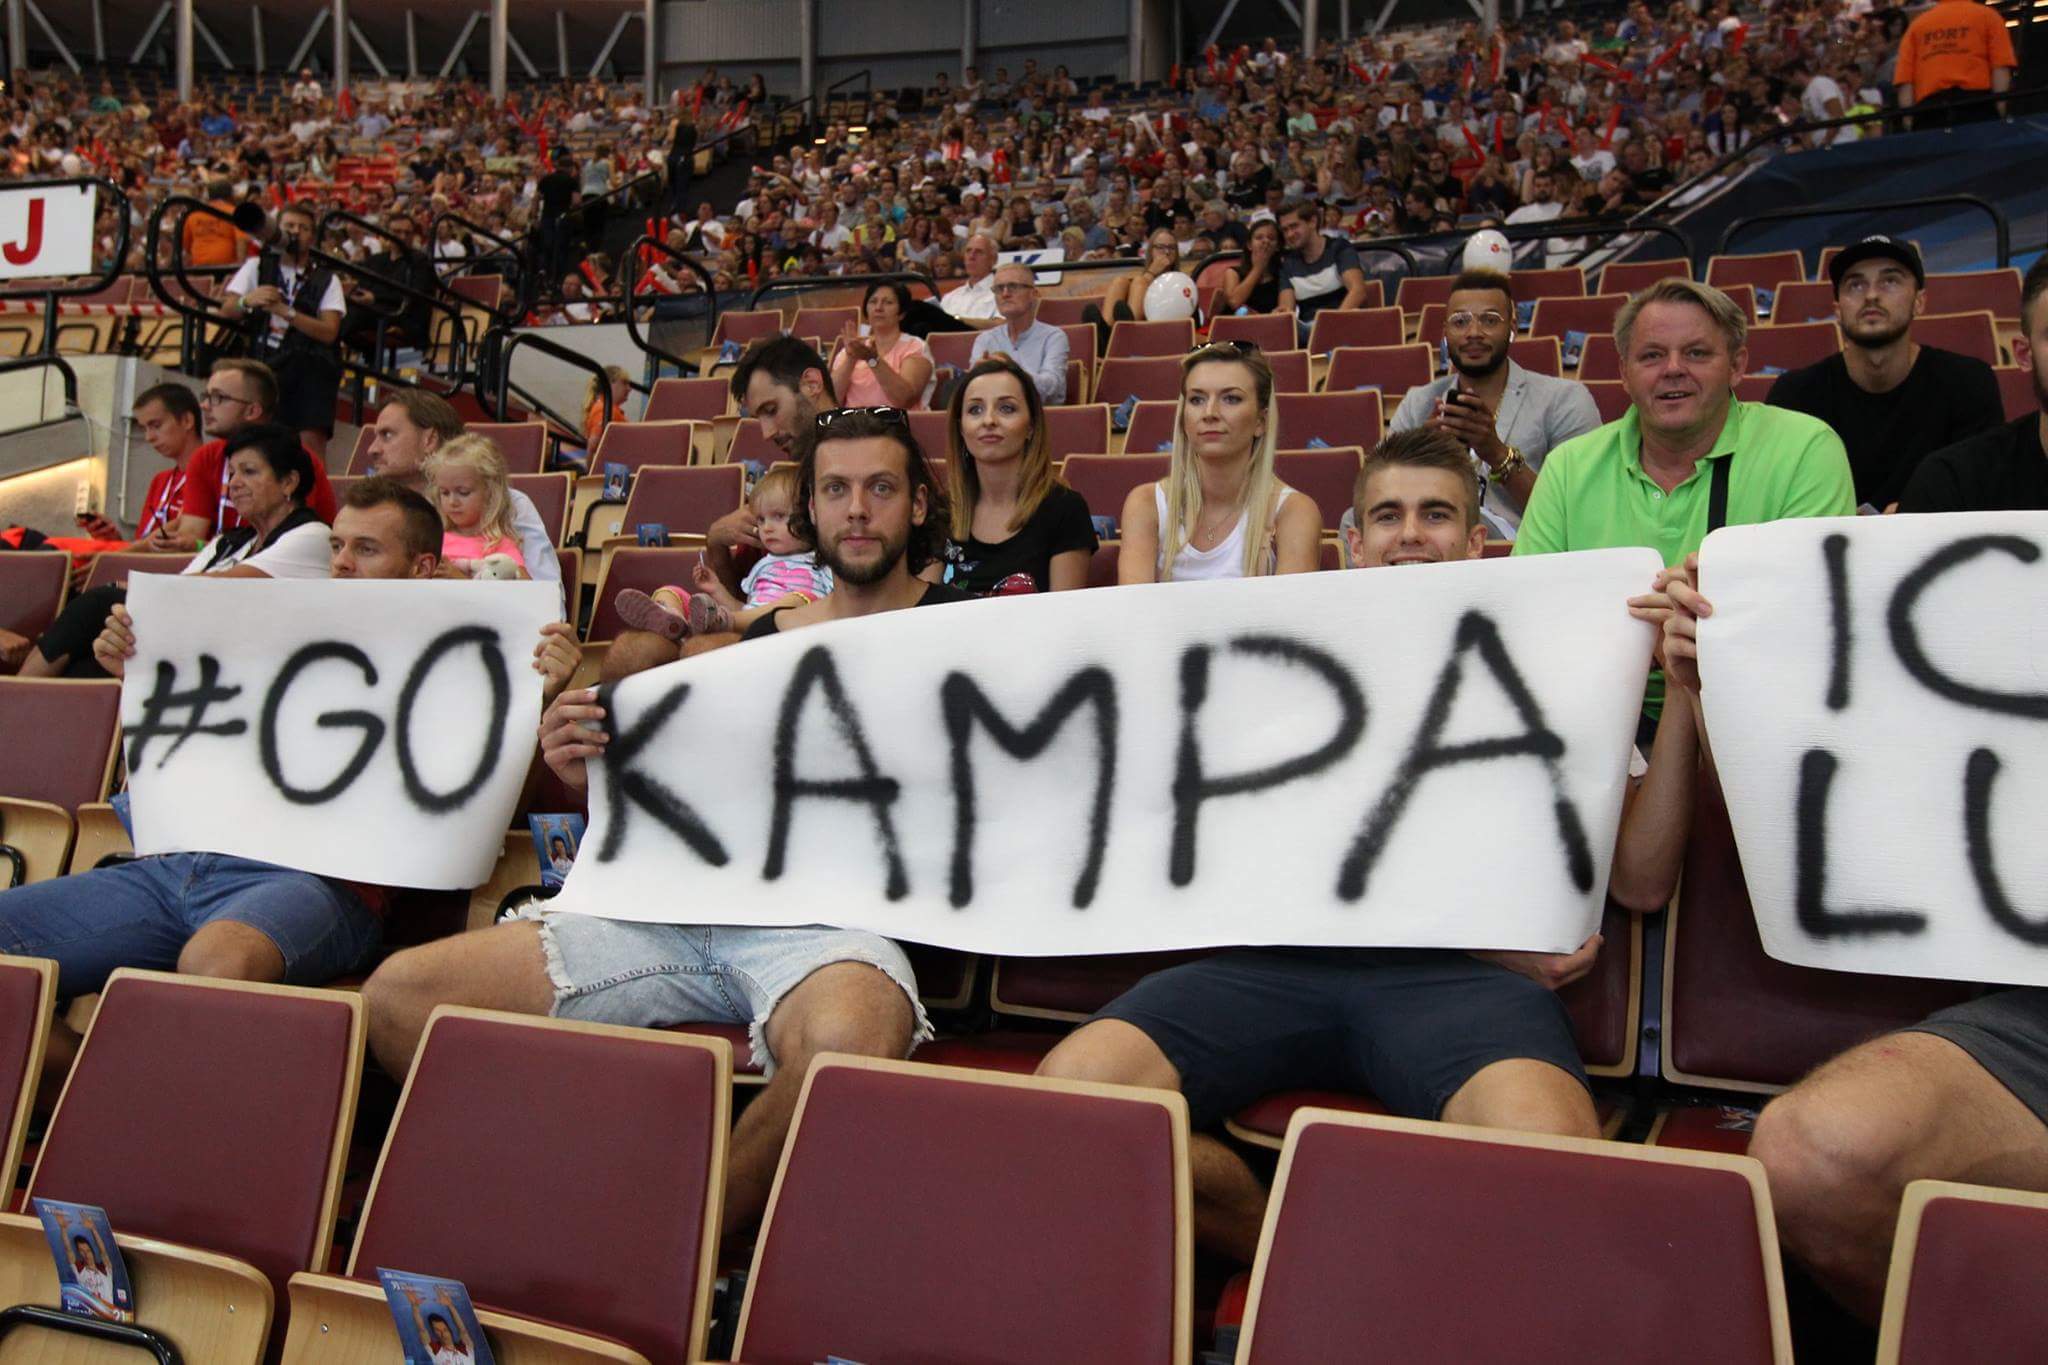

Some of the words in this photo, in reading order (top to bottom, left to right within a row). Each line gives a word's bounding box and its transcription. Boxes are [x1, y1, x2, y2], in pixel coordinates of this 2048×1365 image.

[3, 198, 45, 266] J
[123, 624, 511, 816] #GO
[592, 608, 1598, 909] KAMPA
